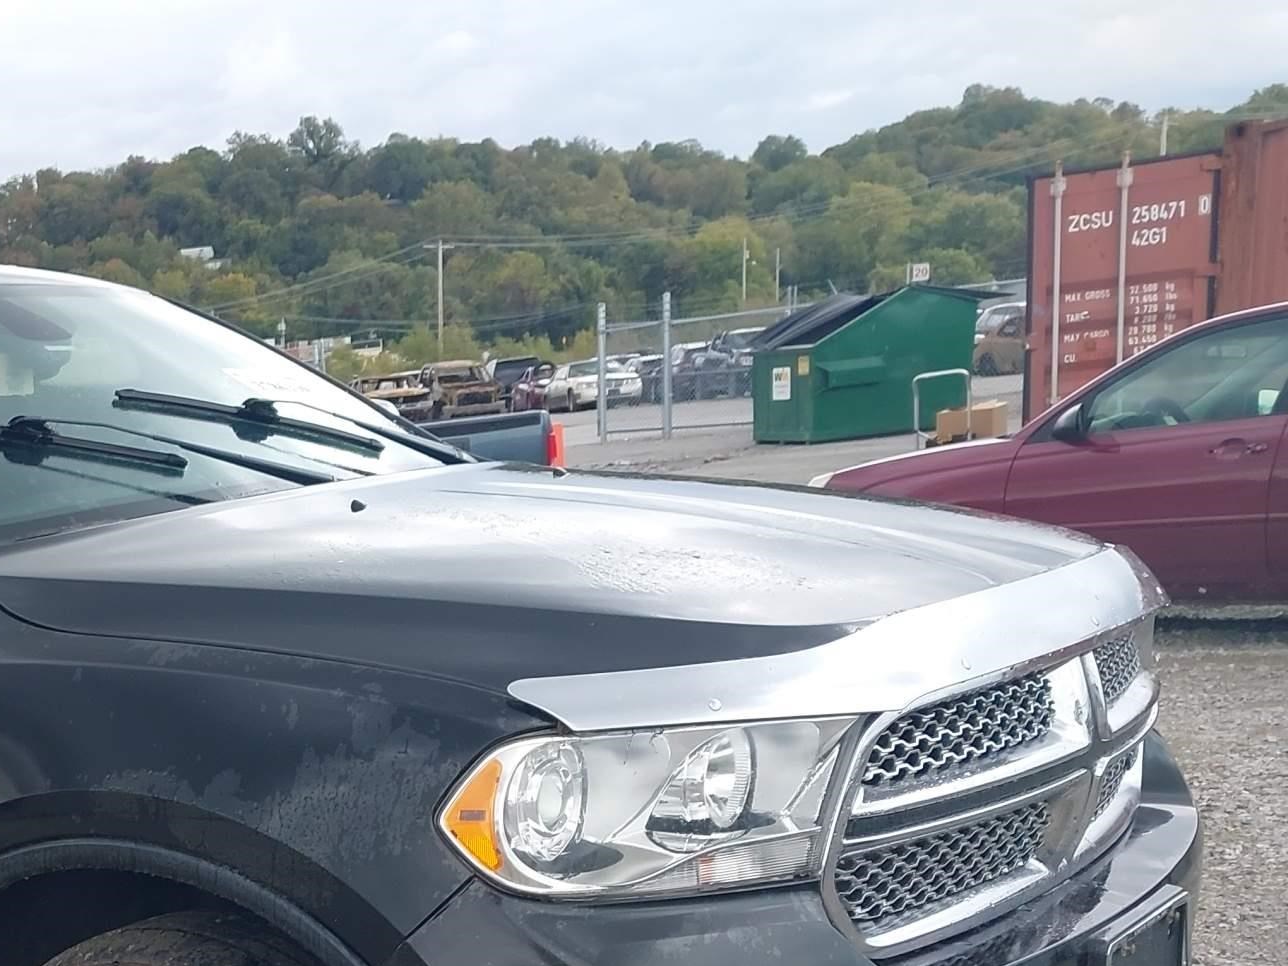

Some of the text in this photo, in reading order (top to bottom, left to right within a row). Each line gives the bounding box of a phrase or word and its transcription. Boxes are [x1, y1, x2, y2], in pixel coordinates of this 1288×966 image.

[1068, 210, 1113, 232] ZCSU
[1132, 200, 1186, 224] 258471
[1131, 227, 1167, 246] 42G1
